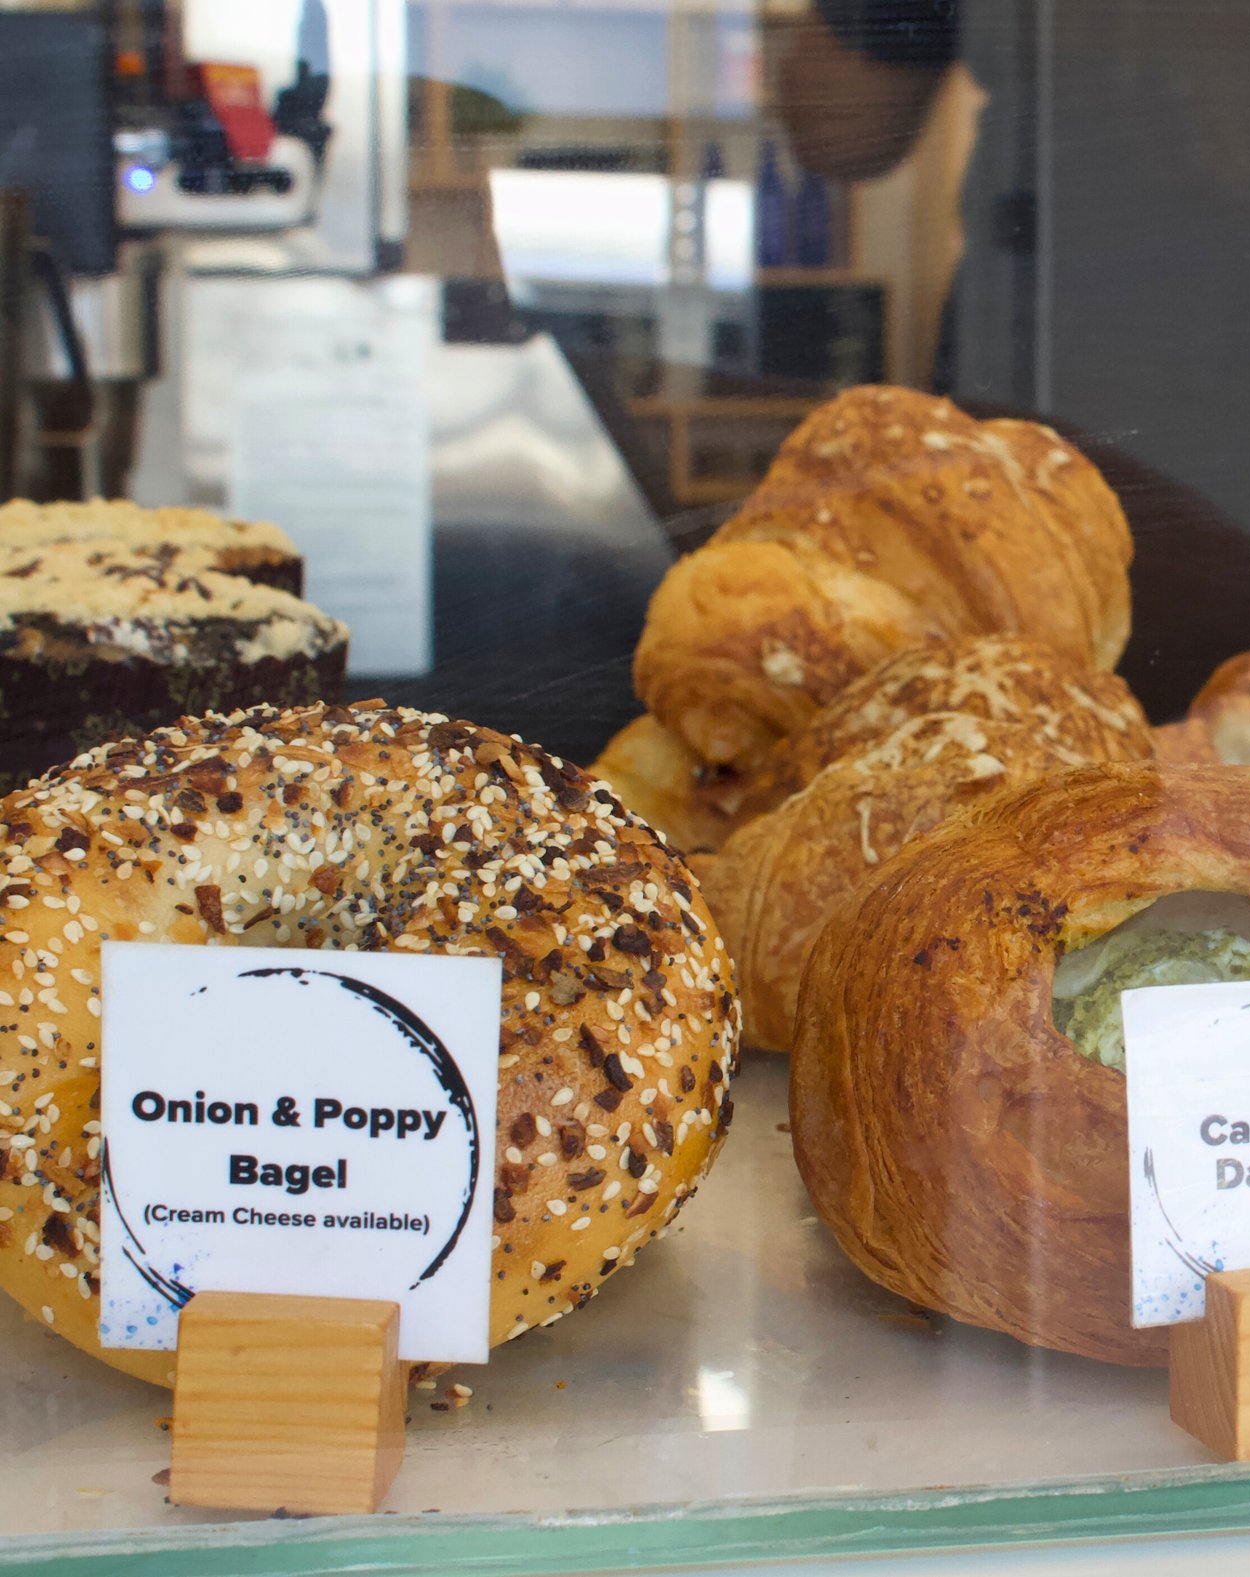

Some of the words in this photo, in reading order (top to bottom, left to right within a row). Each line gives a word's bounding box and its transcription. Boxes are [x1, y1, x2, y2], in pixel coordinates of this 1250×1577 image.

[131, 1090, 259, 1126] Onion
[271, 1096, 302, 1128] &
[313, 1098, 447, 1141] Poppy
[228, 1154, 348, 1195] Bagel
[143, 1203, 226, 1227] (Cream
[231, 1206, 317, 1229] Cheese
[322, 1210, 431, 1237] available)
